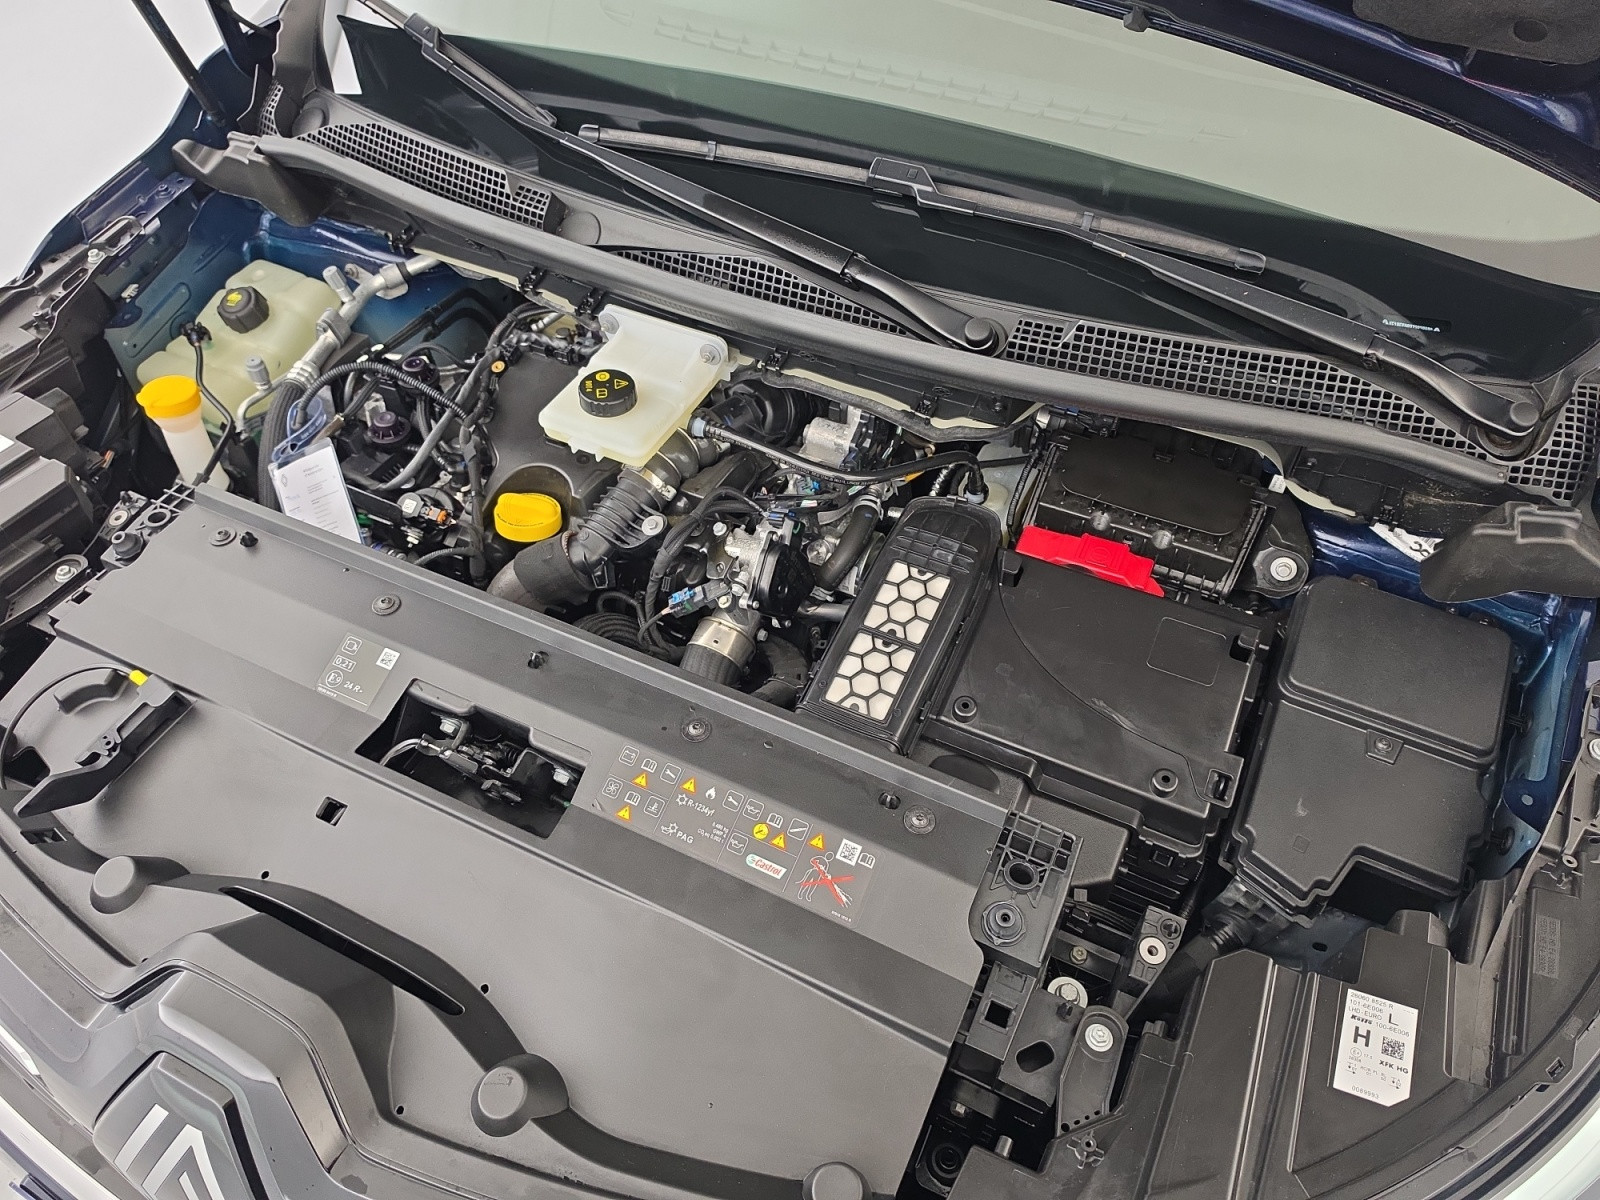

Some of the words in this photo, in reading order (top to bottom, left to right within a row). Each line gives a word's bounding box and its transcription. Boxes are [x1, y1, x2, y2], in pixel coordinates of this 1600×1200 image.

[336, 657, 353, 669] 0.21
[687, 799, 716, 816] R-1234yf
[676, 830, 694, 844] PAG
[755, 858, 782, 876] Castrol
[1388, 1013, 1399, 1026] L
[1352, 1026, 1371, 1048] H
[1378, 1060, 1394, 1070] XFK
[1396, 1065, 1409, 1074] HG
